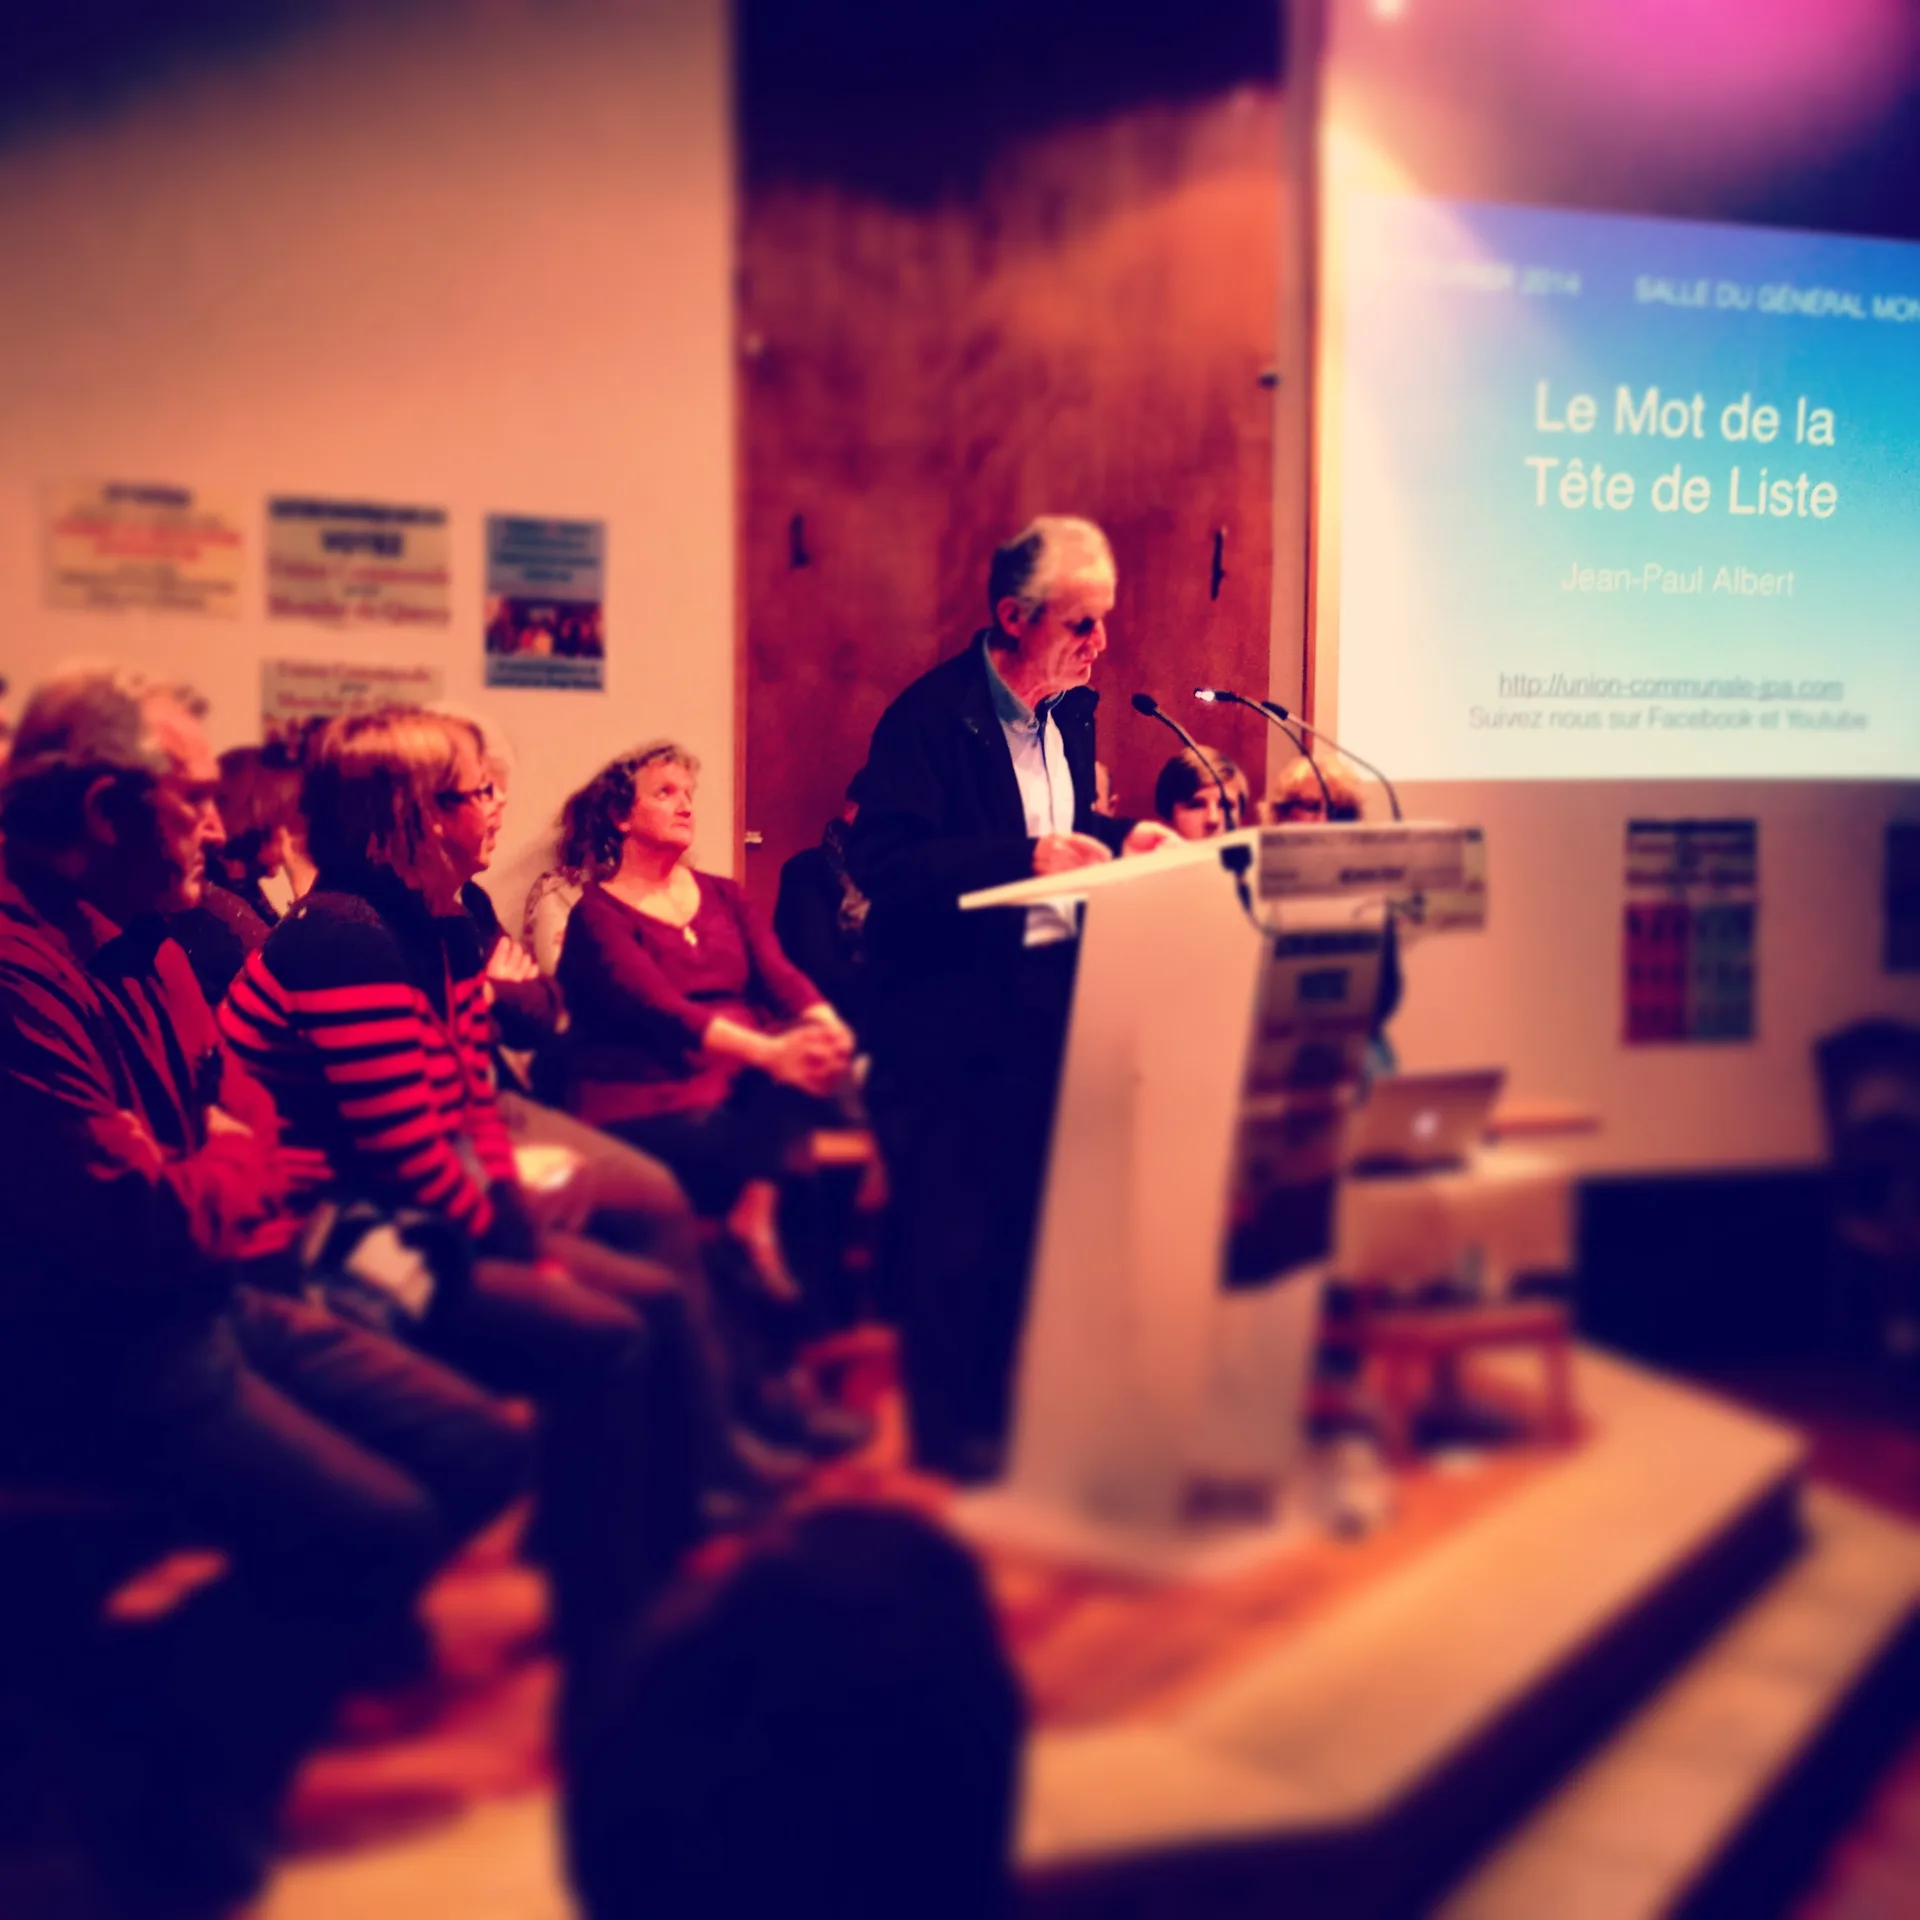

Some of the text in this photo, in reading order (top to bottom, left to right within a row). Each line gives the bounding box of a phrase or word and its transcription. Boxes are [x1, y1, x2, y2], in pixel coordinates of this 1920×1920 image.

[1635, 275, 1709, 308] SALLE
[1716, 280, 1753, 310] DU
[1535, 379, 1836, 446] Le Mot de la
[1524, 455, 1838, 518] Tête de Liste
[1561, 561, 1795, 597] Jean-Paul Albert
[1468, 704, 1543, 730] Suivez
[1549, 710, 1602, 730] nous
[1608, 710, 1641, 731] sur
[1648, 704, 1751, 731] Facebook
